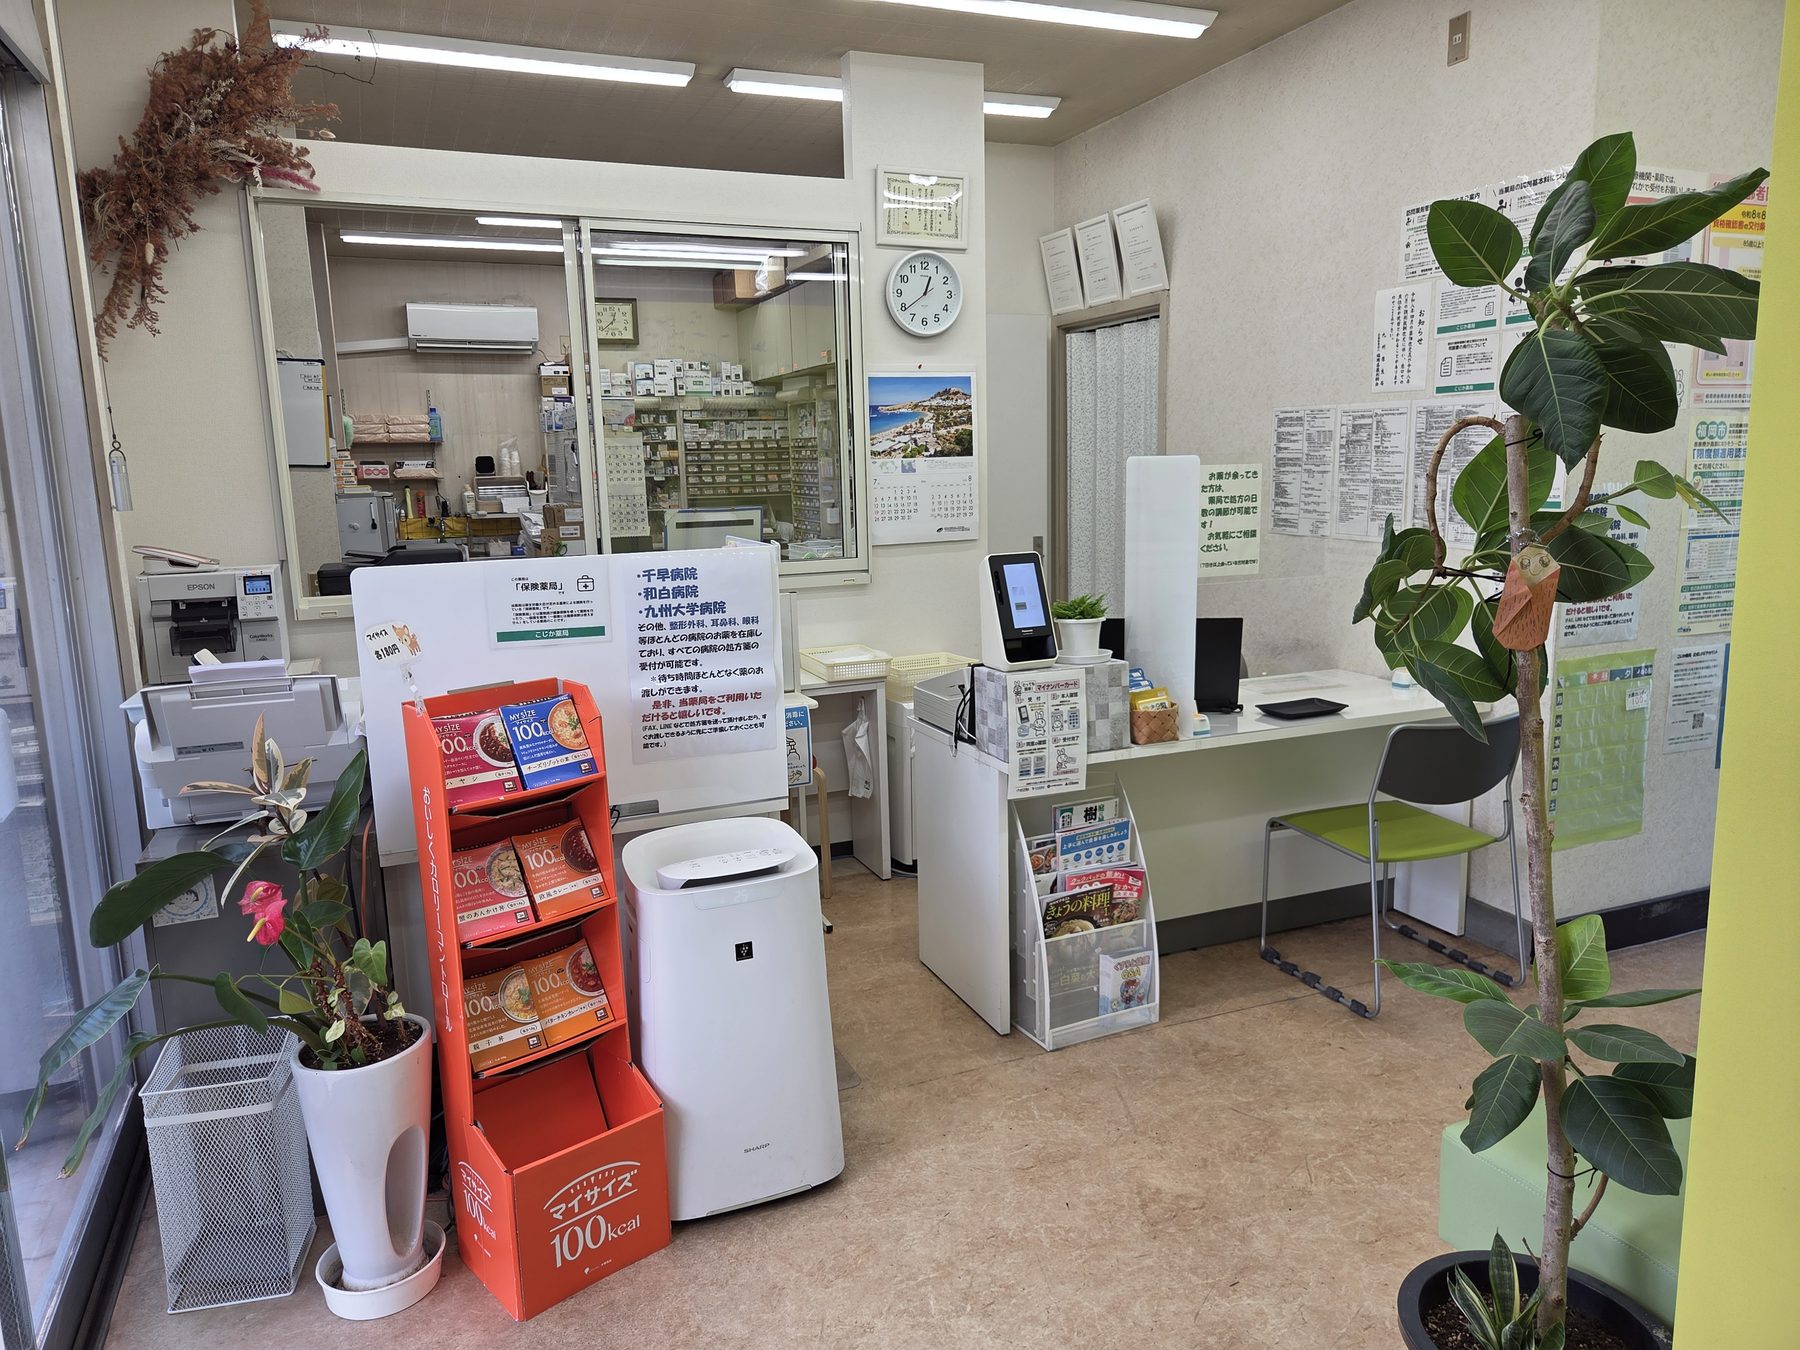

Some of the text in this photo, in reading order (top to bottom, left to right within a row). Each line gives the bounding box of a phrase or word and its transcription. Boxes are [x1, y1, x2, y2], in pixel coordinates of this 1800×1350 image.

[909, 265, 916, 273] 11
[920, 261, 929, 270] 12
[935, 266, 939, 274] 1
[900, 275, 909, 283] 10
[943, 277, 949, 285] 2
[896, 289, 902, 297] 9
[947, 290, 953, 299] 3
[900, 303, 907, 312] 8
[943, 304, 949, 312] 4
[909, 313, 916, 322] 7
[922, 317, 928, 326] 6
[934, 314, 940, 322] 5
[1417, 310, 1425, 345] お知らせ
[1697, 424, 1726, 438] 福岡市
[1208, 471, 1258, 480] お薬が余ってき
[1208, 494, 1257, 505] 薬局で処方の日
[1208, 530, 1257, 540] お気軽にご相談
[1200, 543, 1228, 552] ください。
[187, 583, 215, 591] EPSON
[516, 582, 563, 592] 「保険薬局」
[638, 616, 759, 631] その他、整形外科、耳鼻科、眼科
[536, 630, 569, 638] こじか薬局
[638, 629, 762, 645] 等ほとんどの病院のお薬を在庫し
[374, 644, 400, 660] 各180円
[639, 658, 702, 671] 受付が可能です。
[1037, 681, 1078, 691] マイナンバーカード
[641, 685, 702, 698] 渡しができます。
[642, 707, 726, 722] だけると嬉しいです。
[442, 736, 478, 754] 00kcal
[528, 757, 569, 770] チーズリゾットの素
[422, 786, 453, 1033] おいしくカロリーコントロール
[1047, 891, 1110, 919] きょうの料理
[459, 905, 505, 922] 蟹のあんかけ丼
[744, 1143, 770, 1154] SHARP
[461, 1168, 492, 1205] マイサイズ
[549, 1169, 638, 1220] マイサイズ
[463, 1189, 496, 1240] 100kcal
[550, 1214, 640, 1268] 100kcal
